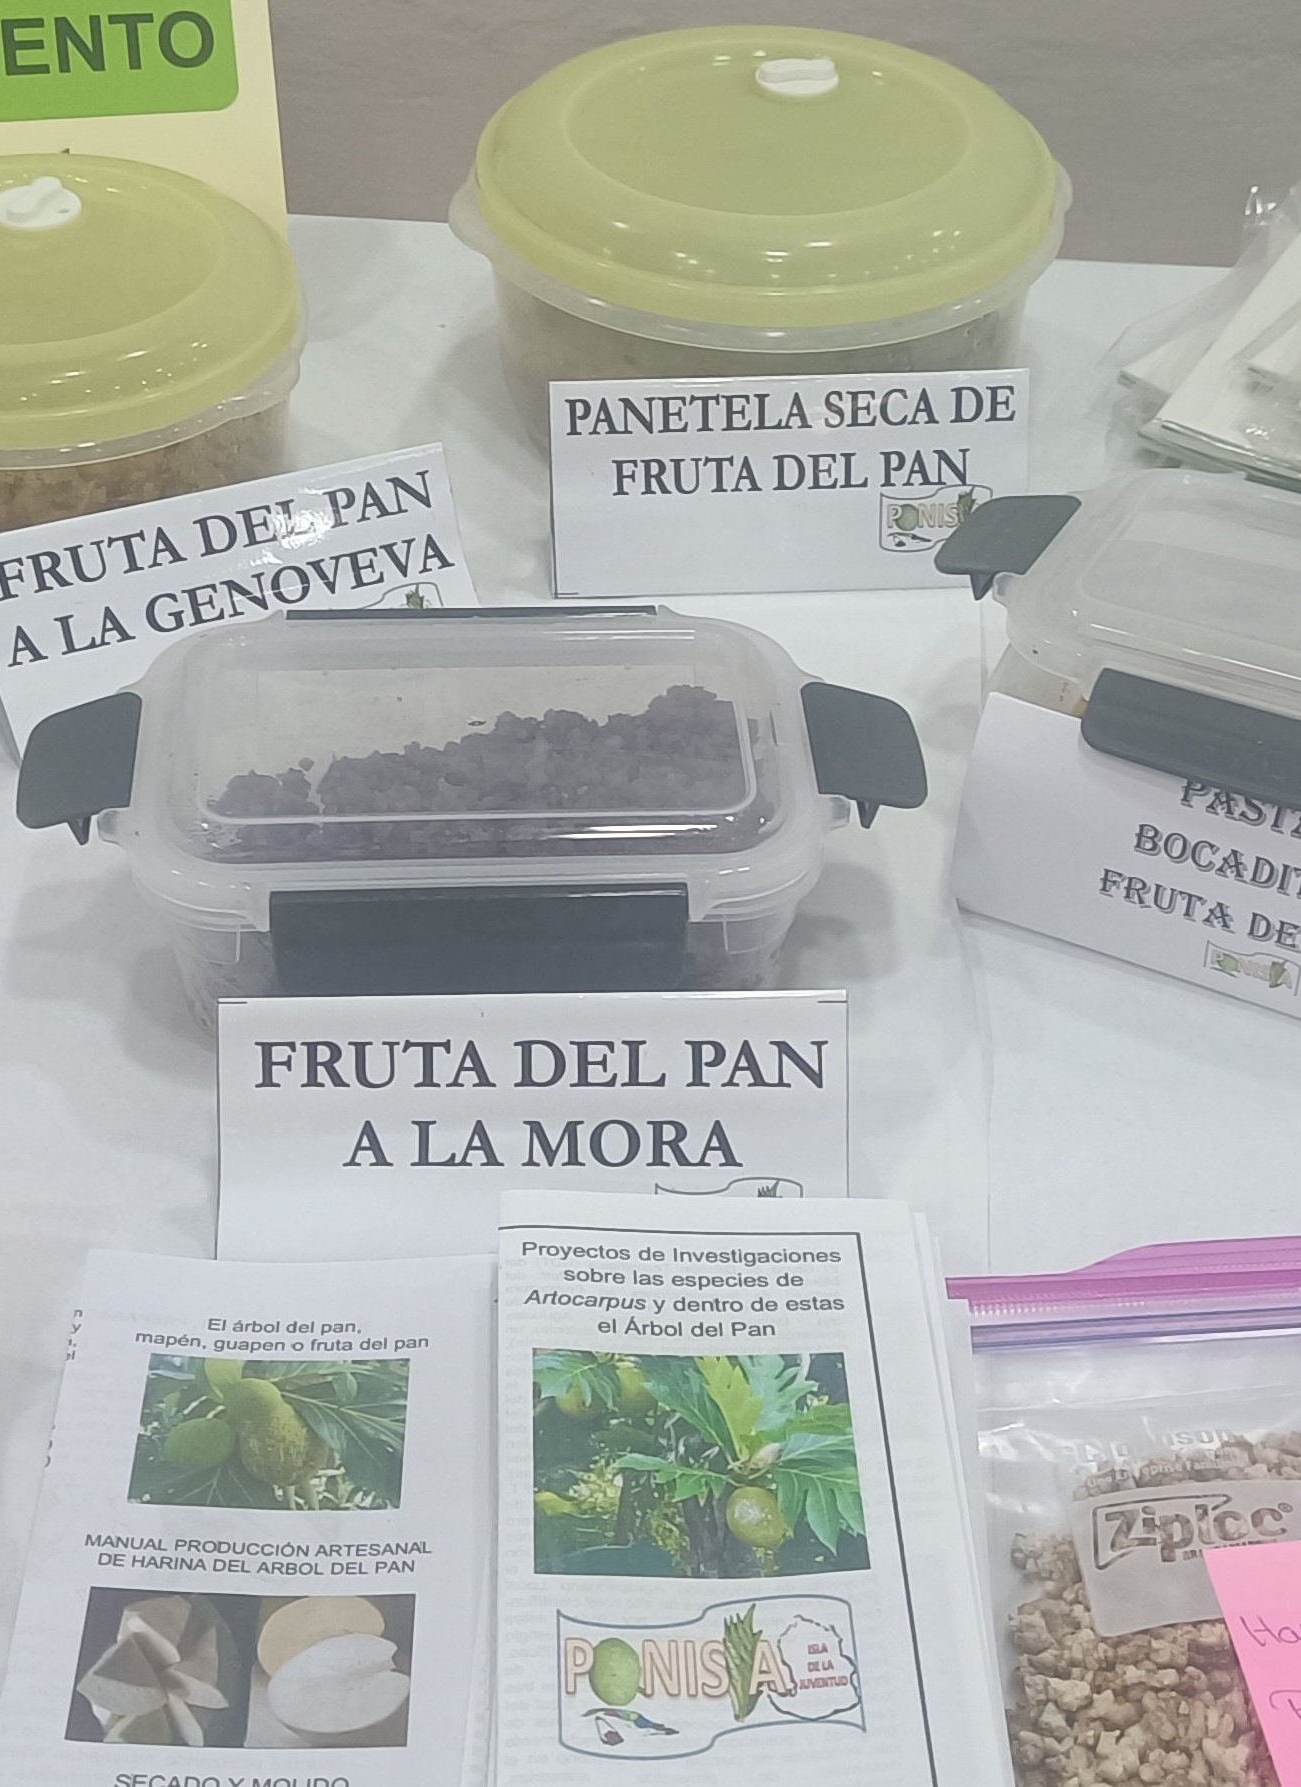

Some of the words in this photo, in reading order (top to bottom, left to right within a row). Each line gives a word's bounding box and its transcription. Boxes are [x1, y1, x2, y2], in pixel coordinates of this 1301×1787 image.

[565, 391, 812, 436] PANETELA
[824, 387, 939, 430] SECA
[950, 385, 1017, 424] DE
[612, 454, 762, 496] FRUTA
[772, 452, 869, 492] DEL
[880, 448, 971, 488] PAN
[193, 498, 317, 558] DEL
[323, 469, 434, 528] PAN
[7, 625, 48, 668] A
[54, 605, 136, 657] LA
[145, 533, 455, 633] GENOVEVA
[1099, 868, 1236, 932] FRUTA
[255, 1039, 496, 1089] FRUTA
[513, 1039, 667, 1089] DEL
[685, 1039, 829, 1089] PAN
[342, 1119, 393, 1168] A
[410, 1119, 505, 1168] LA
[522, 1119, 744, 1169] MORA
[522, 1241, 631, 1262] Proyectos
[638, 1246, 665, 1262] de
[673, 1247, 842, 1267] Investigaciones
[563, 1267, 625, 1285] sobre
[633, 1269, 665, 1286] las
[671, 1271, 769, 1291] especies
[776, 1271, 804, 1288] de
[524, 1289, 646, 1313] Artocarpus
[652, 1299, 666, 1316] y
[672, 1295, 744, 1313] dentro
[750, 1296, 778, 1312] de
[785, 1297, 846, 1313] estas
[207, 1318, 226, 1333] El
[232, 1318, 280, 1334] árbol
[285, 1319, 315, 1334] del
[320, 1320, 363, 1337] pan,
[597, 1319, 618, 1335] el
[623, 1316, 683, 1337] Árbol
[690, 1321, 723, 1337] del
[731, 1321, 777, 1337] Pan
[135, 1330, 207, 1351] mapén,
[213, 1337, 285, 1355] guapen
[291, 1341, 304, 1353] o
[310, 1336, 353, 1352] fruta
[359, 1336, 388, 1352] del
[394, 1336, 429, 1352] pan
[84, 1533, 168, 1552] MANUAL
[174, 1536, 310, 1558] PRODUCCIÓN
[314, 1540, 433, 1557] ARTESANAL
[97, 1552, 126, 1568] DE
[131, 1555, 206, 1572] HARINA
[212, 1558, 251, 1574] DEL
[257, 1558, 324, 1576] ARBOL
[330, 1560, 368, 1575] DEL
[375, 1559, 416, 1574] PAN
[799, 1675, 848, 1690] JUVENTUD
[114, 1772, 220, 1787] SECADO
